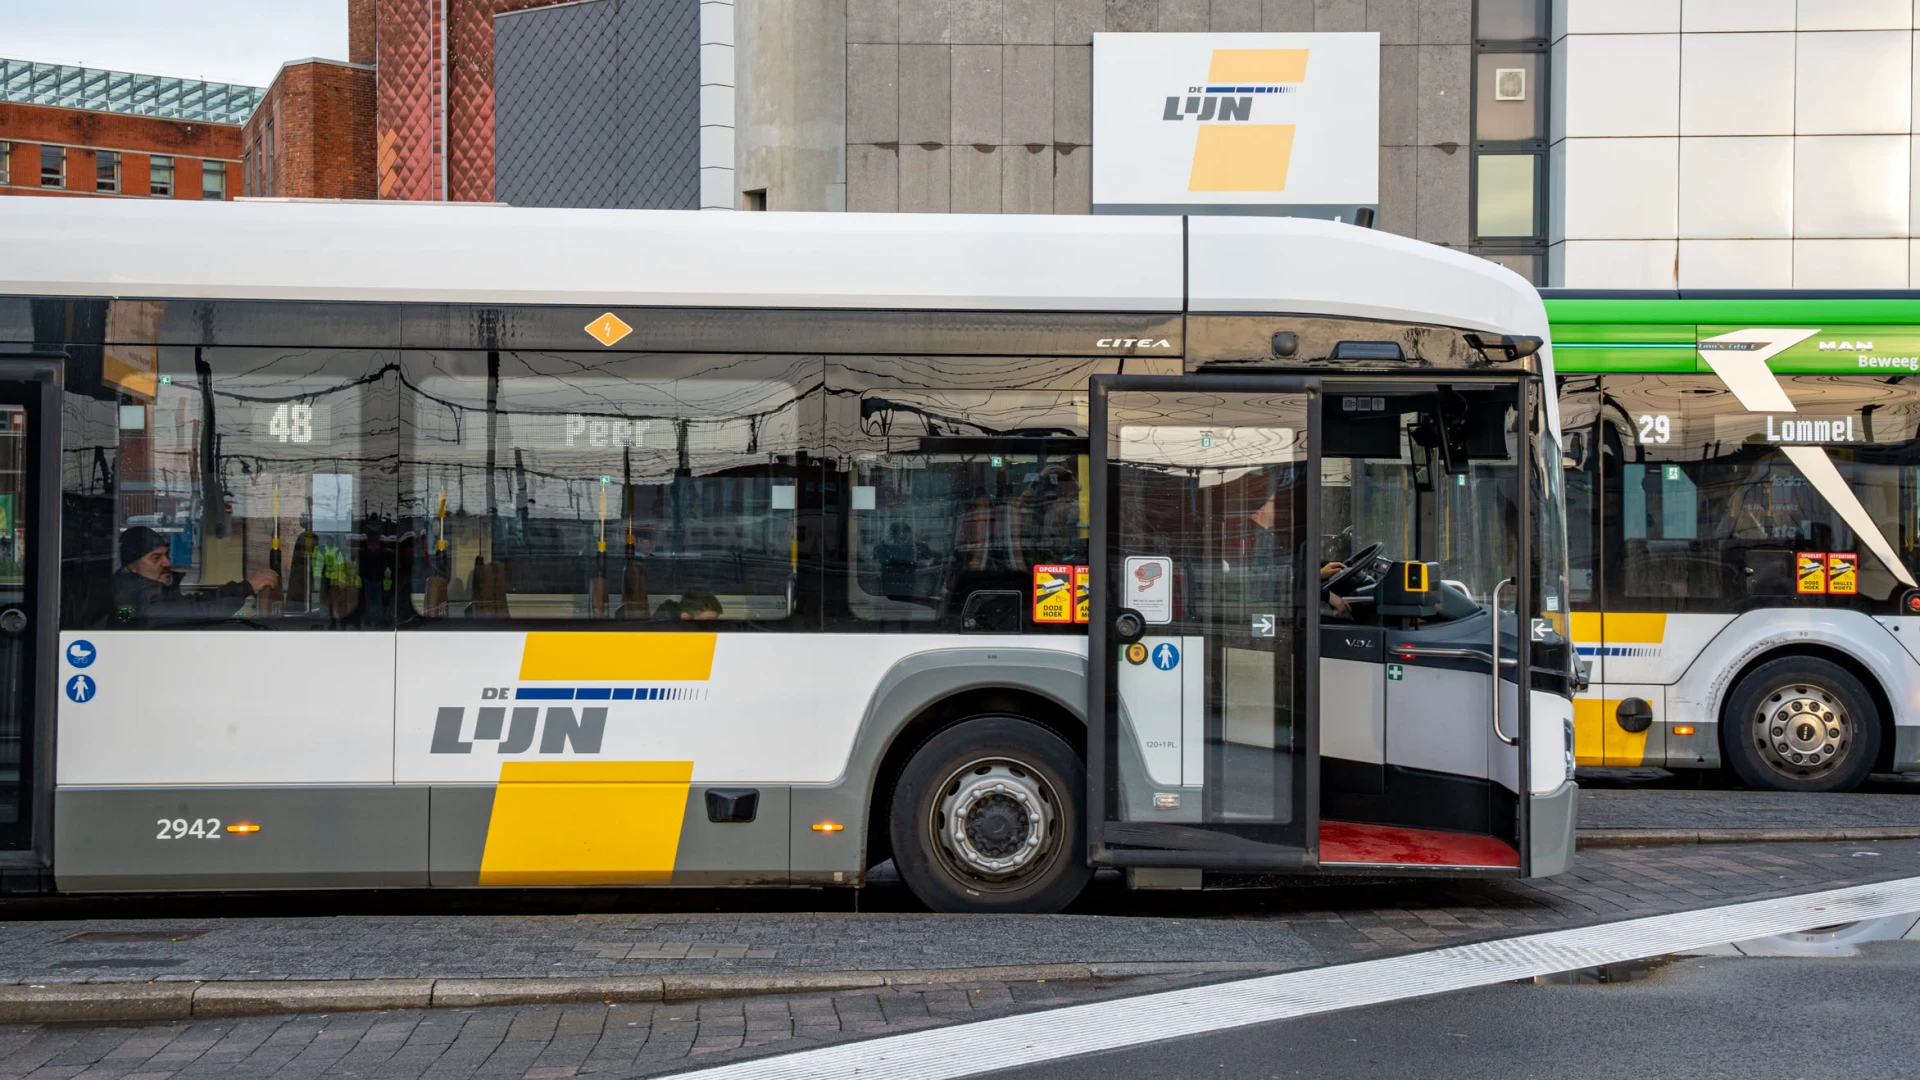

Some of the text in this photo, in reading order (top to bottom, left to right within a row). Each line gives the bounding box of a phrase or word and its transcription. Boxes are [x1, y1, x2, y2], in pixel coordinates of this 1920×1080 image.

[1162, 96, 1253, 121] LIJN
[1096, 338, 1171, 348] CITEA
[1819, 341, 1873, 351] MAN
[1858, 355, 1919, 371] Beweeg
[269, 404, 313, 443] 48
[565, 413, 651, 448] Peer
[1639, 414, 1670, 443] 29
[1766, 416, 1854, 442] Lommel
[1345, 639, 1374, 648] VDL
[481, 687, 510, 700] DE
[429, 706, 609, 754] LIJN
[156, 818, 221, 839] 2942
